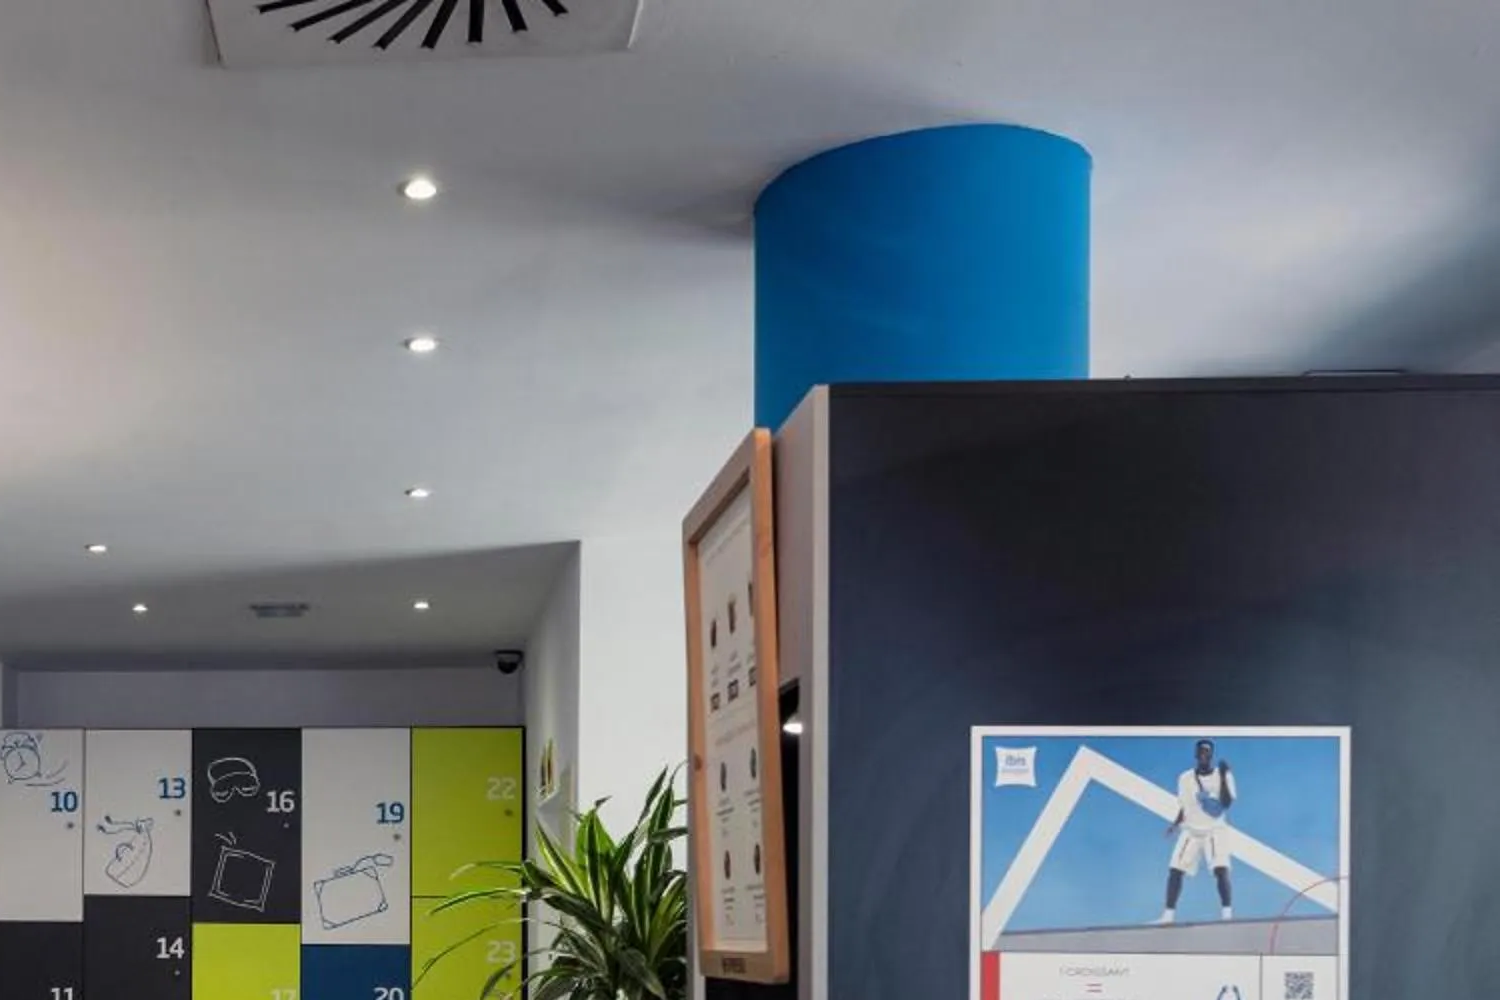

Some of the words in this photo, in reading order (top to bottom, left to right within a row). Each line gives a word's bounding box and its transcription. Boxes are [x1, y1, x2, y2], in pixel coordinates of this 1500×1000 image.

[159, 778, 186, 799] 13
[487, 779, 515, 800] 22
[51, 791, 78, 813] 10
[267, 791, 295, 813] 16
[376, 803, 405, 824] 19
[157, 938, 185, 959] 14
[487, 942, 516, 963] 23
